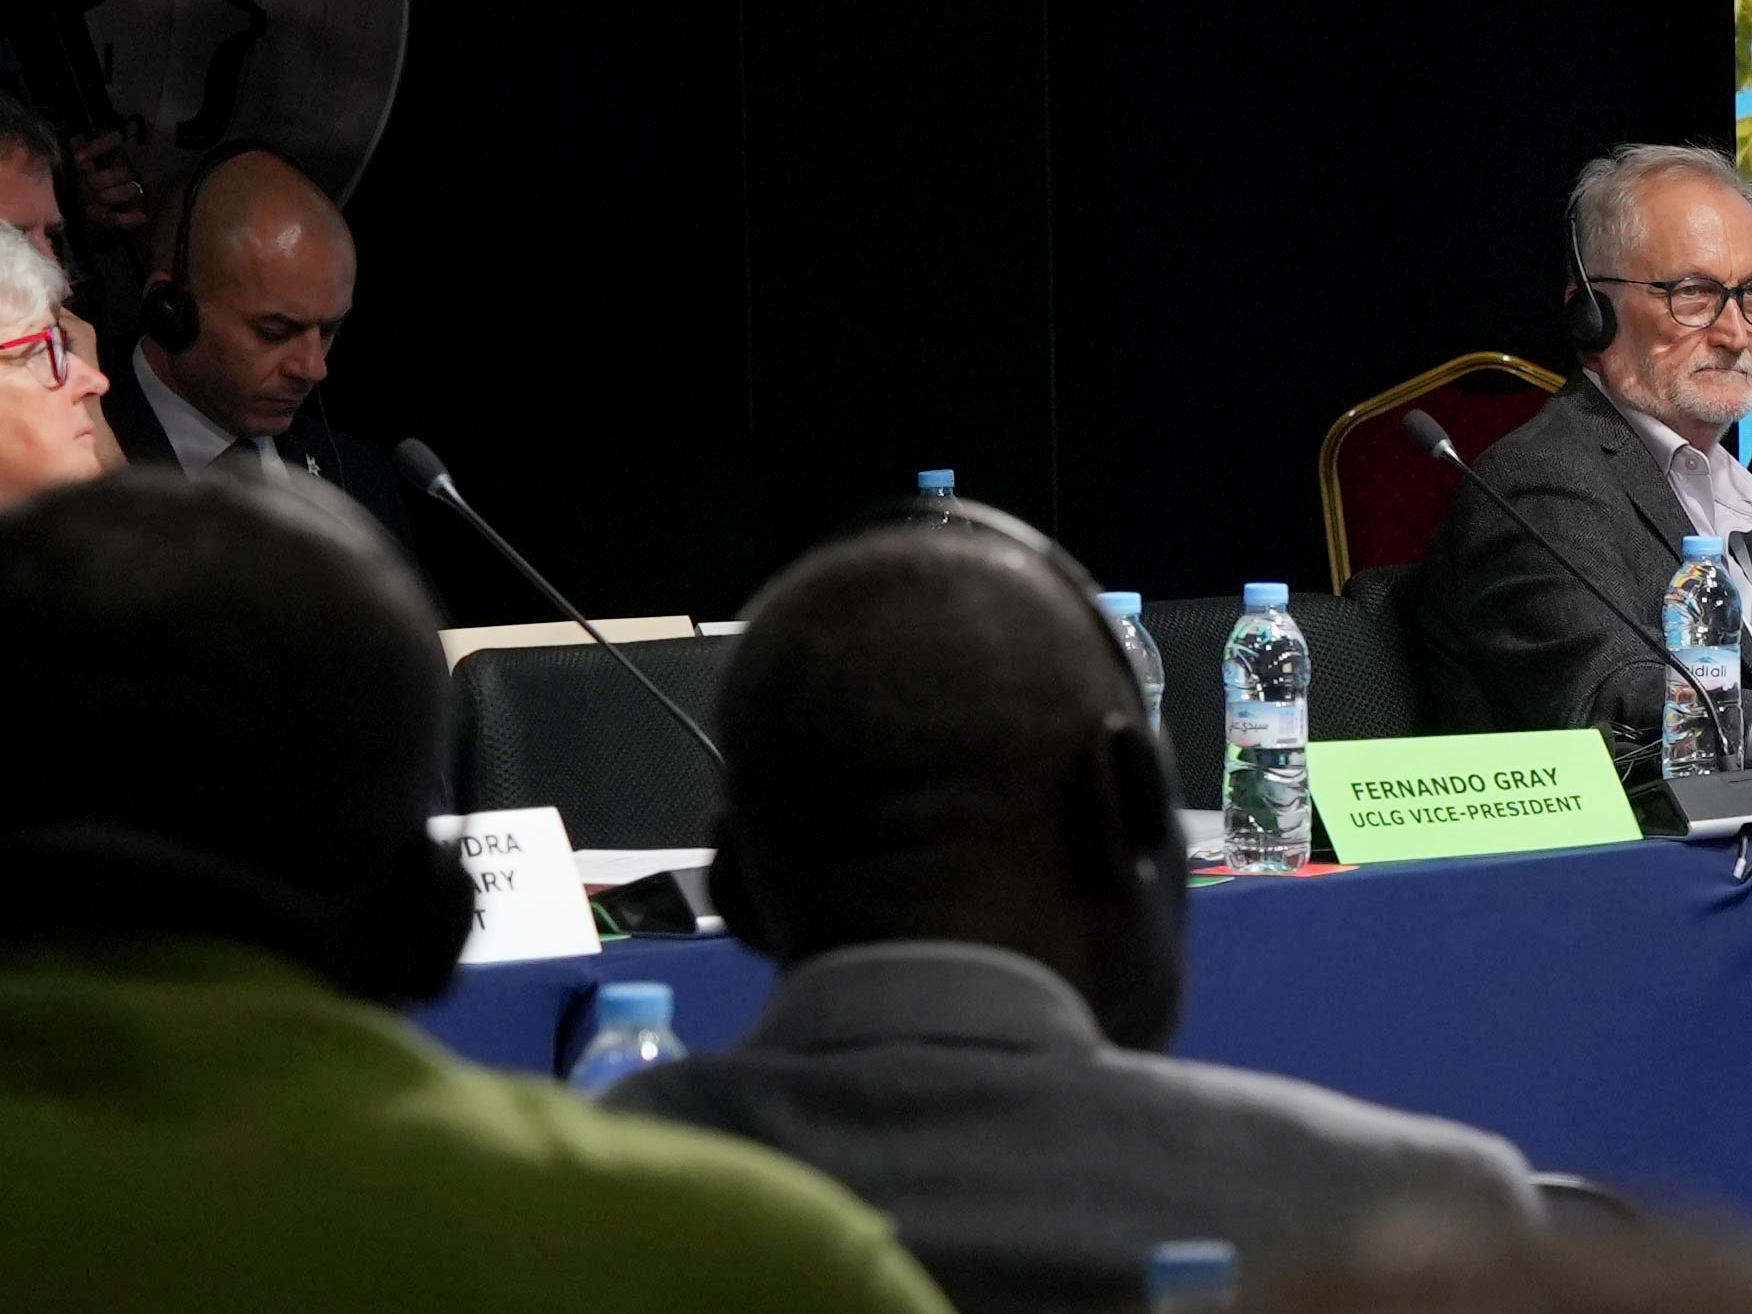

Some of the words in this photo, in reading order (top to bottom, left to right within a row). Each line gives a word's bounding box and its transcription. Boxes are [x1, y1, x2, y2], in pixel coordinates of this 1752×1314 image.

[1687, 665, 1709, 678] idi
[1710, 665, 1727, 678] ali
[1350, 774, 1486, 801] FERNANDO
[1493, 767, 1559, 791] GRAY
[1350, 810, 1406, 828] UCLG
[1409, 795, 1583, 824] VICE-PRESIDENT
